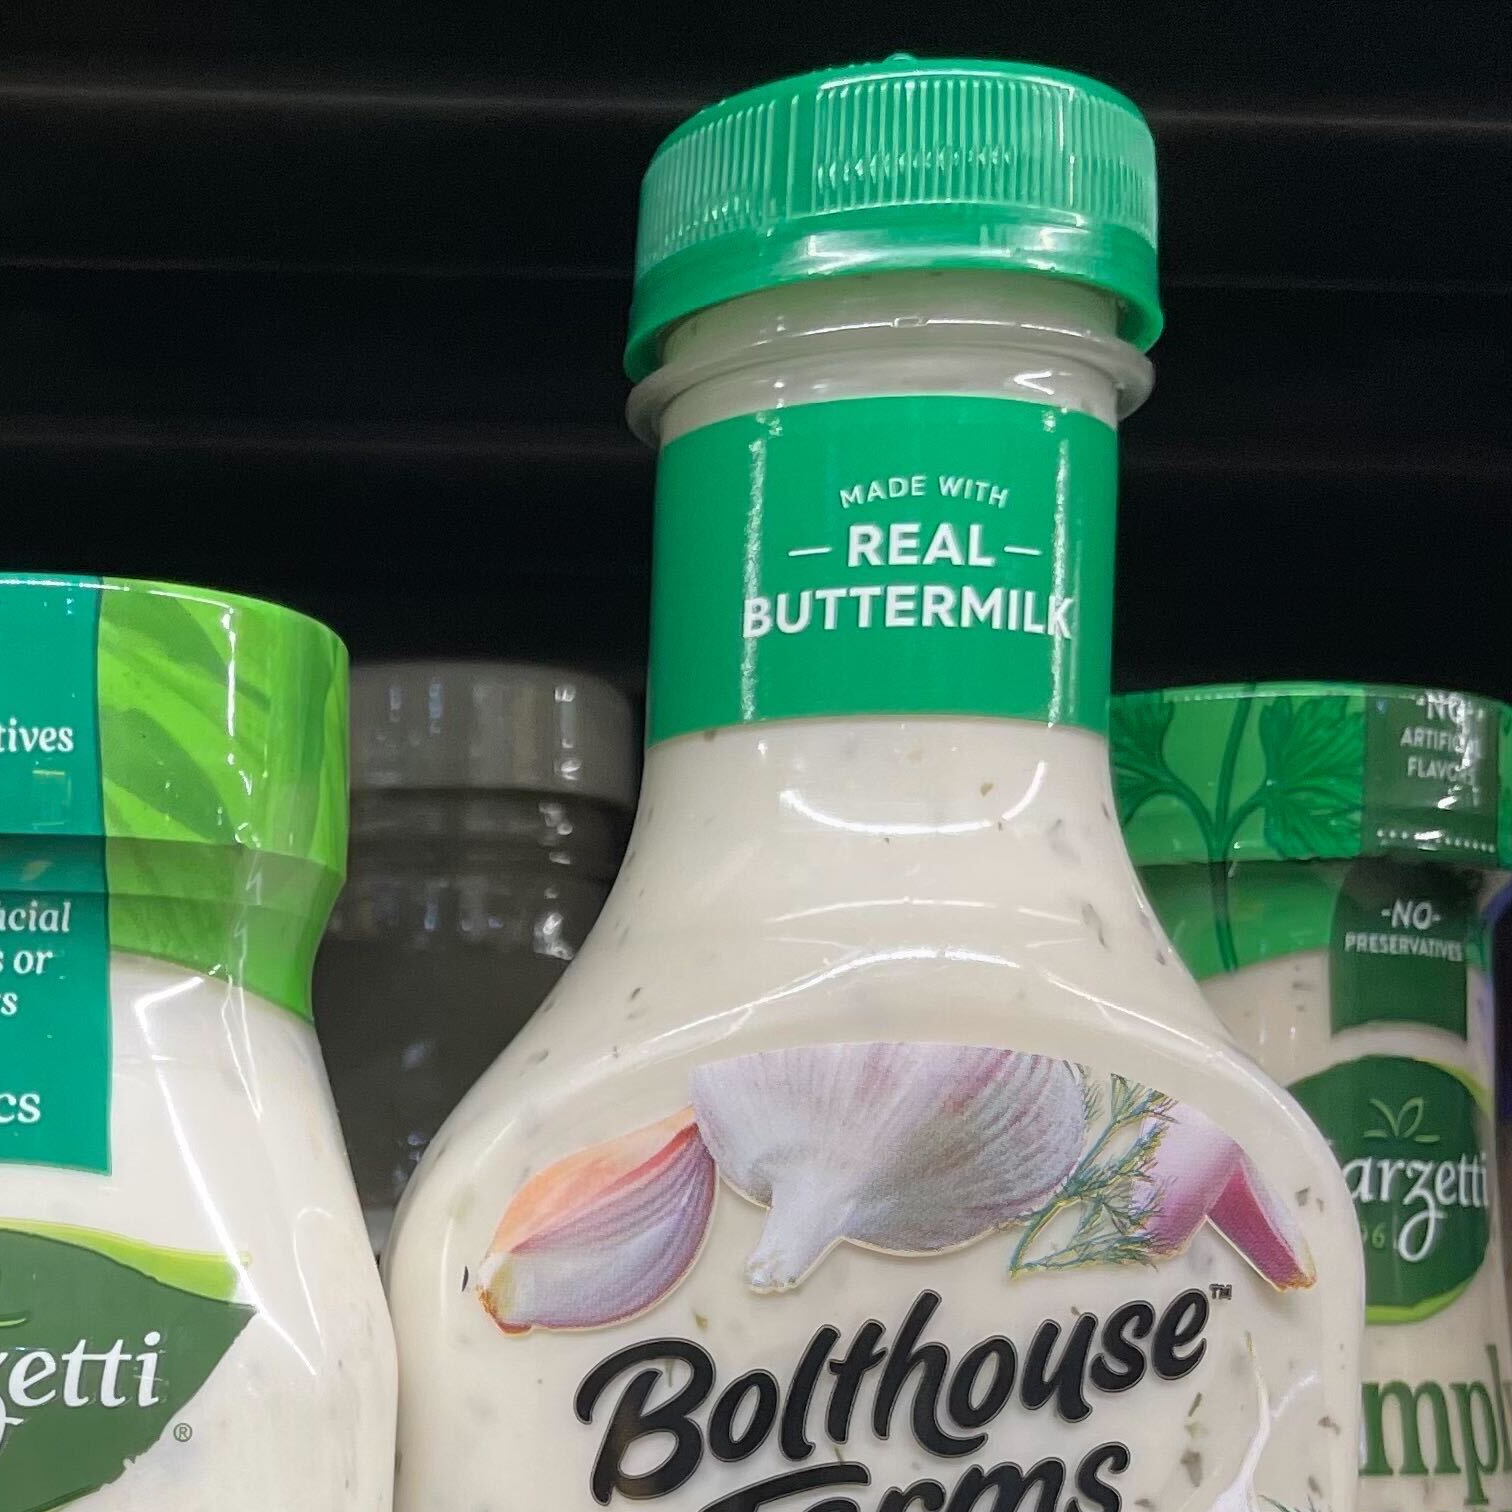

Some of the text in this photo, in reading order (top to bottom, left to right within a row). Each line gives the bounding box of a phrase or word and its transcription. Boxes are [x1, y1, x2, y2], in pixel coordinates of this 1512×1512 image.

[839, 474, 1009, 509] MADE WITH
[848, 522, 995, 567] REAL
[742, 584, 1074, 639] BUTTERMILK
[13, 950, 54, 976] or
[1340, 1152, 1488, 1262] arzetti
[574, 1289, 1209, 1506] Bolthouse
